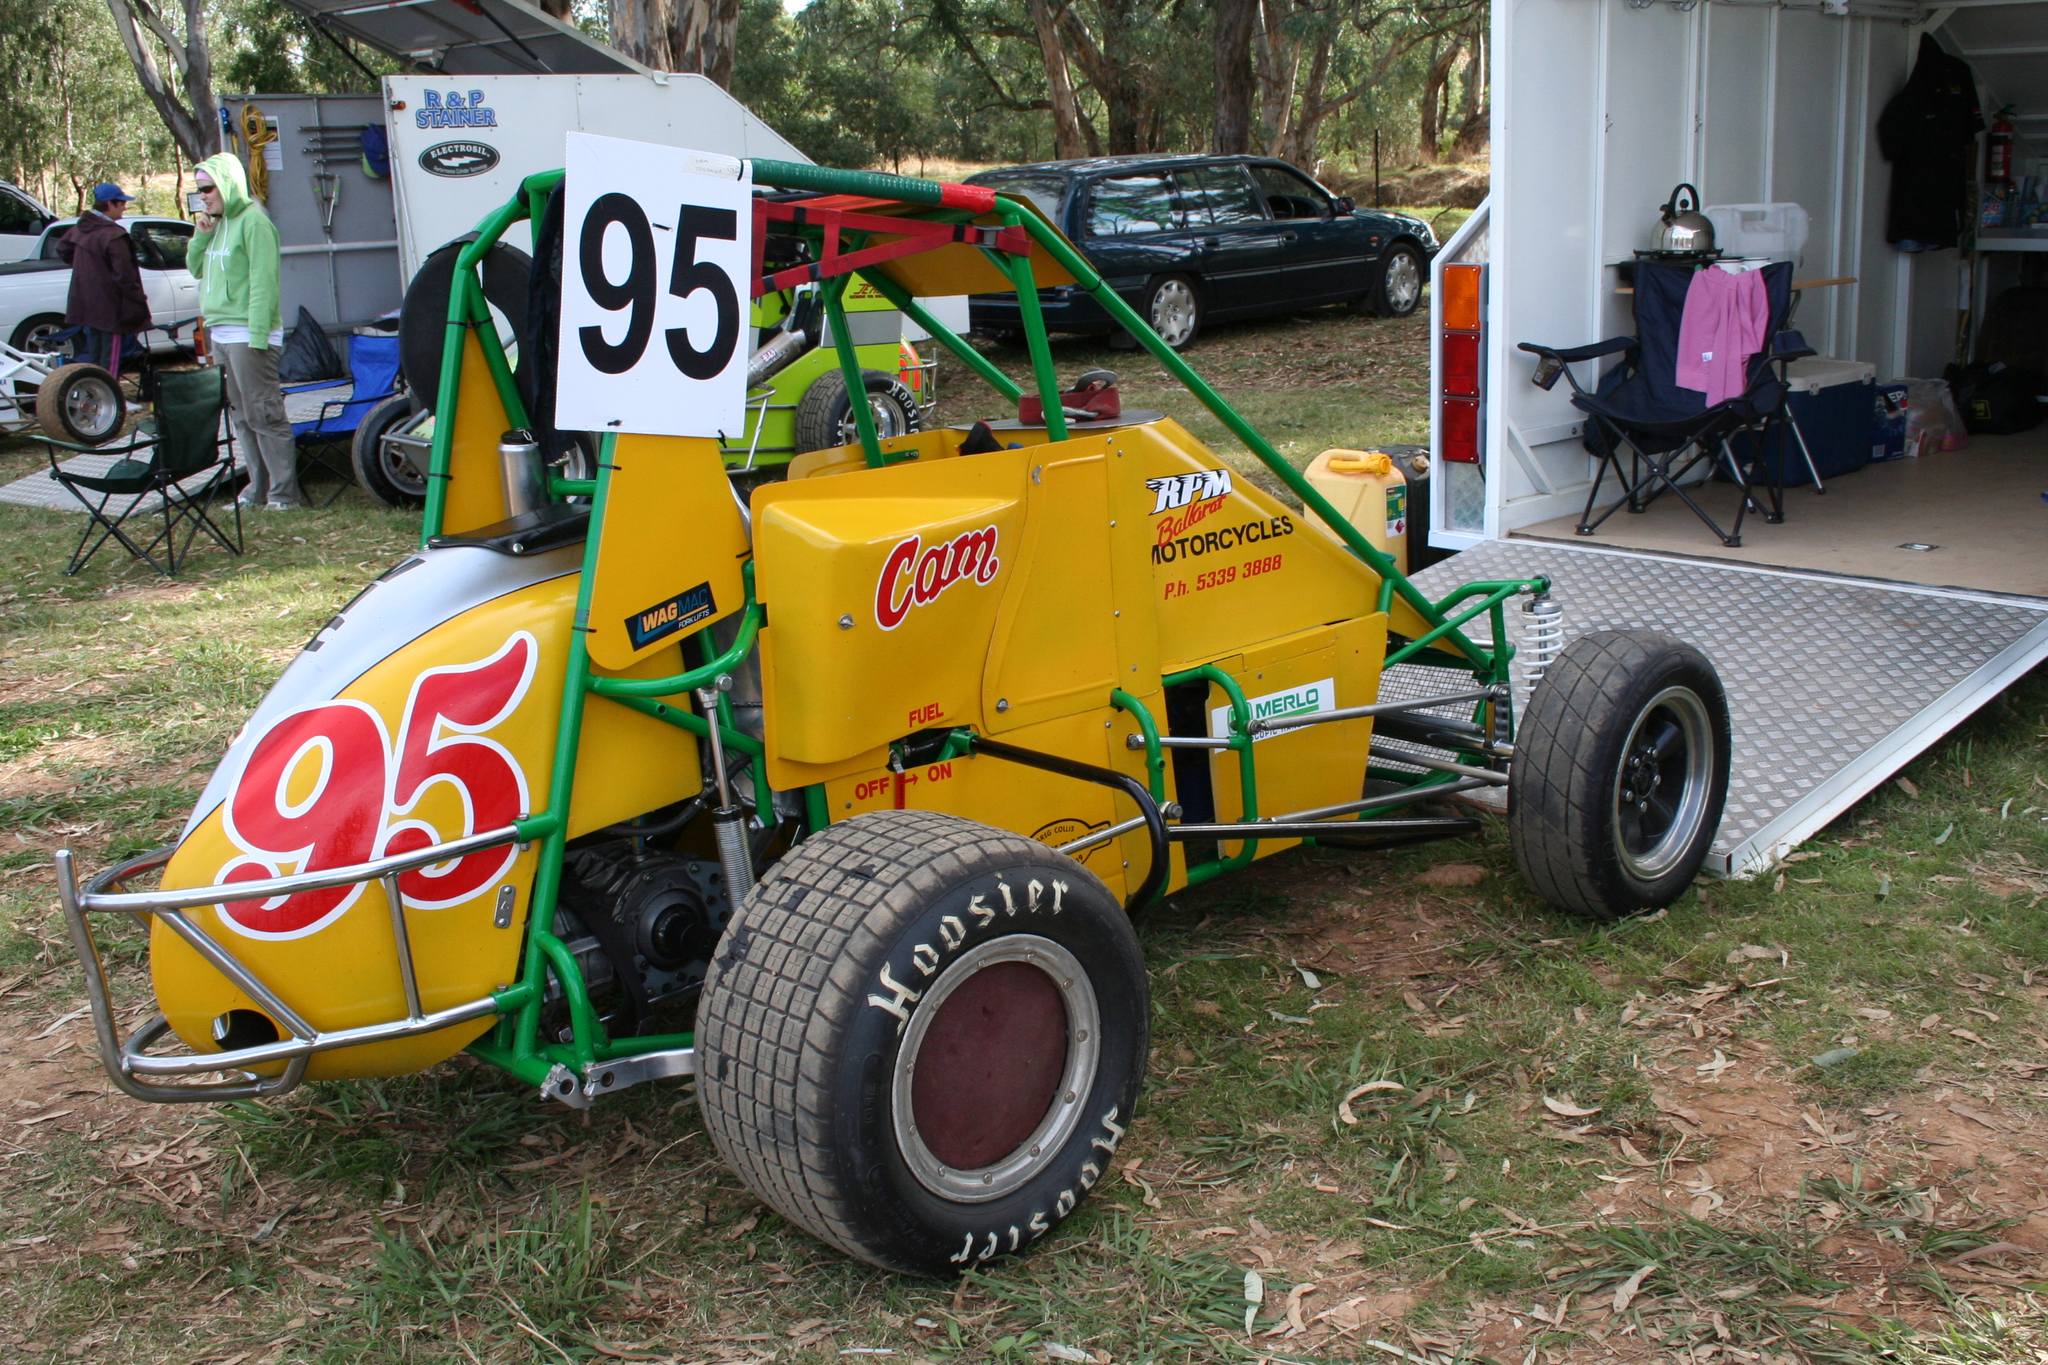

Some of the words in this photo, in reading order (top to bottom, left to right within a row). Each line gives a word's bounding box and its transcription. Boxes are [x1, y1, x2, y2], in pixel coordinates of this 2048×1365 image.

[415, 107, 498, 129] STAINER
[424, 89, 443, 110] R
[446, 91, 466, 109] &
[468, 89, 485, 109] P
[430, 144, 488, 158] ELECTROSIL
[578, 192, 740, 381] 95
[1145, 468, 1233, 516] RPM
[1152, 515, 1295, 566] MOTORCYCLES
[1156, 495, 1229, 549] Ballarat
[875, 525, 1000, 632] Cam
[1196, 566, 1237, 592] 5339
[1242, 554, 1283, 579] 3888
[678, 609, 710, 629] FORKLIFTS
[909, 702, 945, 728] FUEL
[1256, 688, 1319, 719] MERLO
[213, 630, 538, 941] 95
[855, 776, 890, 801] OFF
[927, 762, 952, 782] ON
[867, 872, 1069, 1037] Hoosier
[950, 1105, 1126, 1264] Hoosier
